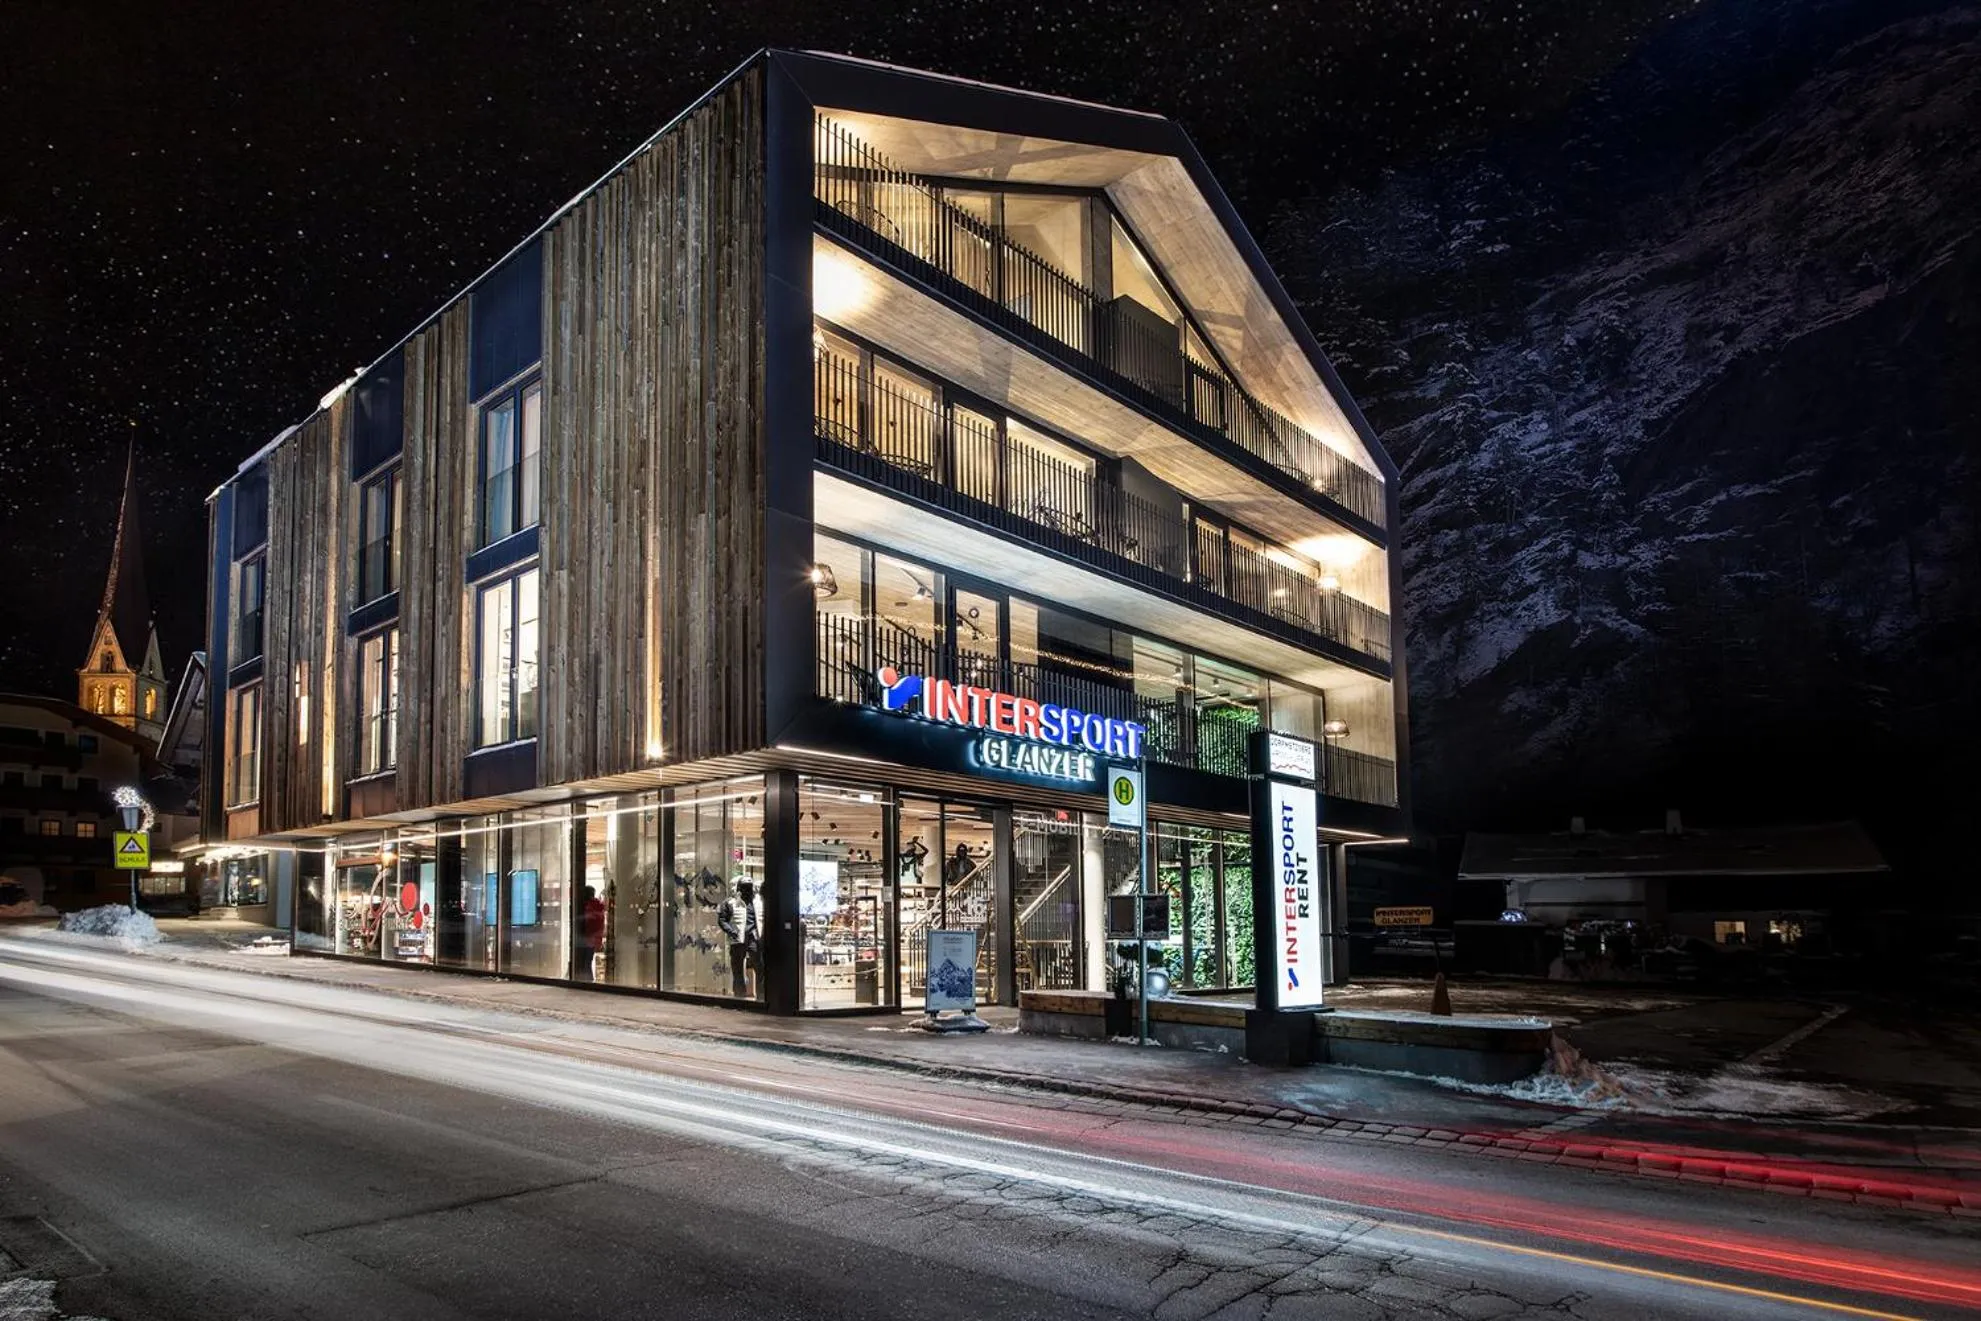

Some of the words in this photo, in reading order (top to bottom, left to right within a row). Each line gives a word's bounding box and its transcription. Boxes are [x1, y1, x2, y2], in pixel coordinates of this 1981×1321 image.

[923, 675, 1146, 759] INTERSPORT
[982, 737, 1095, 781] GLANZER
[1119, 781, 1130, 800] H
[1282, 801, 1298, 963] INTERSPORT
[1296, 852, 1309, 918] RENT
